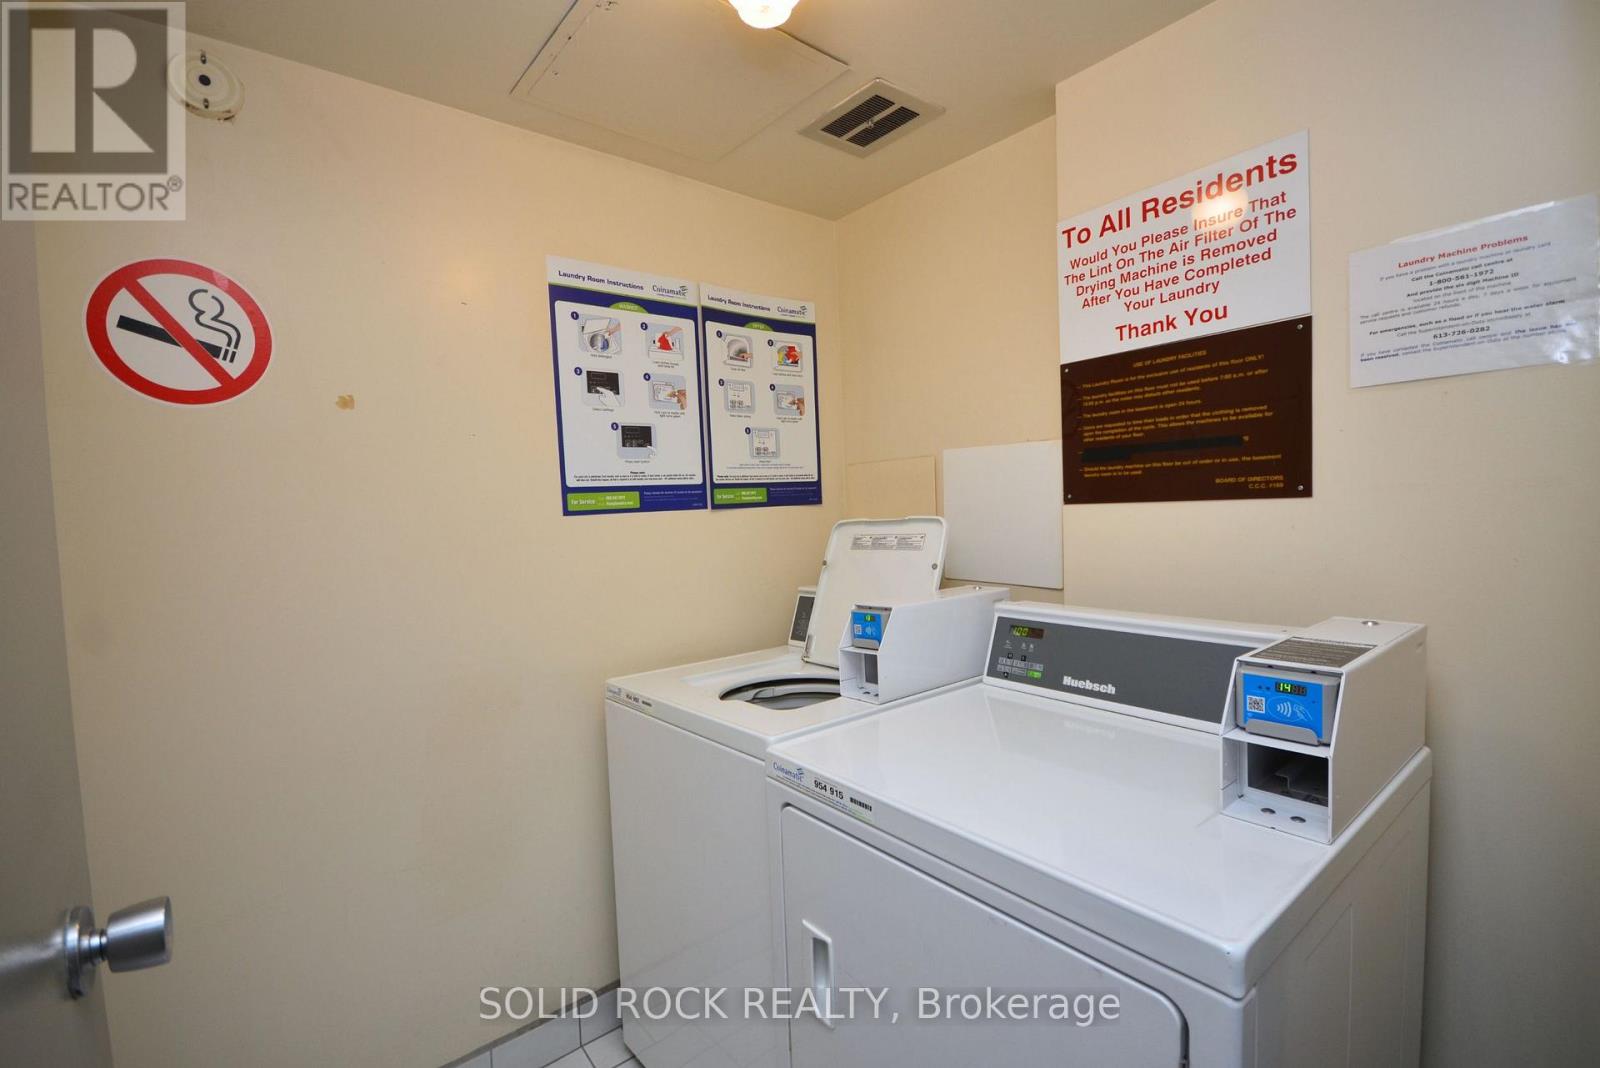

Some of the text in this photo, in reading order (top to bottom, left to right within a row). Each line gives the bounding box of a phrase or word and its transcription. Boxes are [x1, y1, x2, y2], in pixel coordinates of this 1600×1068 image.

[1062, 154, 1296, 248] To All Residents
[1064, 207, 1295, 283] The Lint On The Air Filter Of The
[1069, 192, 1286, 269] Would You Please Insure That
[1075, 229, 1277, 297] Drying Machine is Removed
[1398, 256, 1434, 268] Laundry
[1438, 247, 1477, 258] Machine
[1480, 236, 1527, 249] Problems
[558, 270, 644, 291] Laundry Room Instructions
[1082, 248, 1271, 308] After You Have Completed
[707, 295, 727, 304] Laundry
[742, 302, 771, 312] Instructions
[1124, 281, 1219, 310] Your Laundry
[1116, 306, 1228, 340] Thank You
[1062, 675, 1116, 695] Huebsch
[814, 780, 844, 800] 954 915
